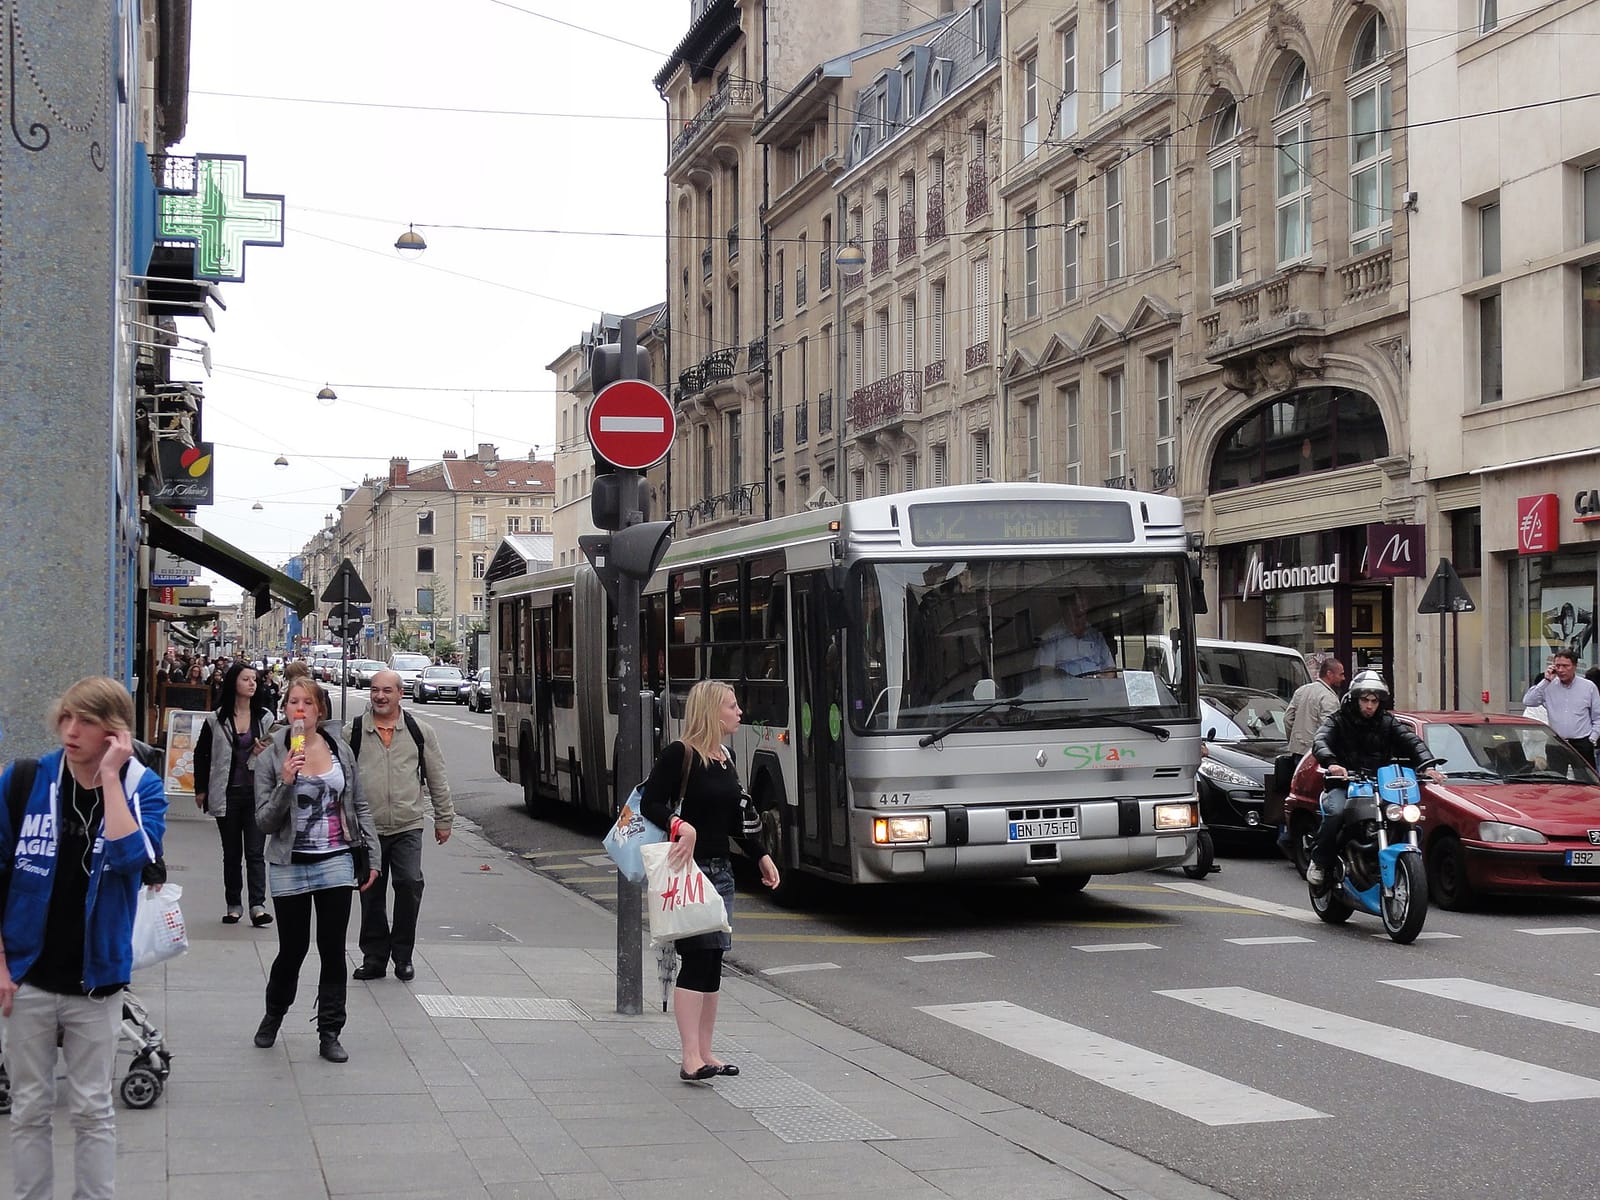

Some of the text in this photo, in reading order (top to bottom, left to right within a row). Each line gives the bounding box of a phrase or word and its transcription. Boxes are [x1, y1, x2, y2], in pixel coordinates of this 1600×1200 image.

[1004, 519, 1080, 538] MAIRIE
[1242, 552, 1340, 602] Marionnaud
[1063, 742, 1136, 769] Stan
[879, 793, 911, 805] 447
[1574, 852, 1593, 865] 992
[660, 871, 705, 911] H&M
